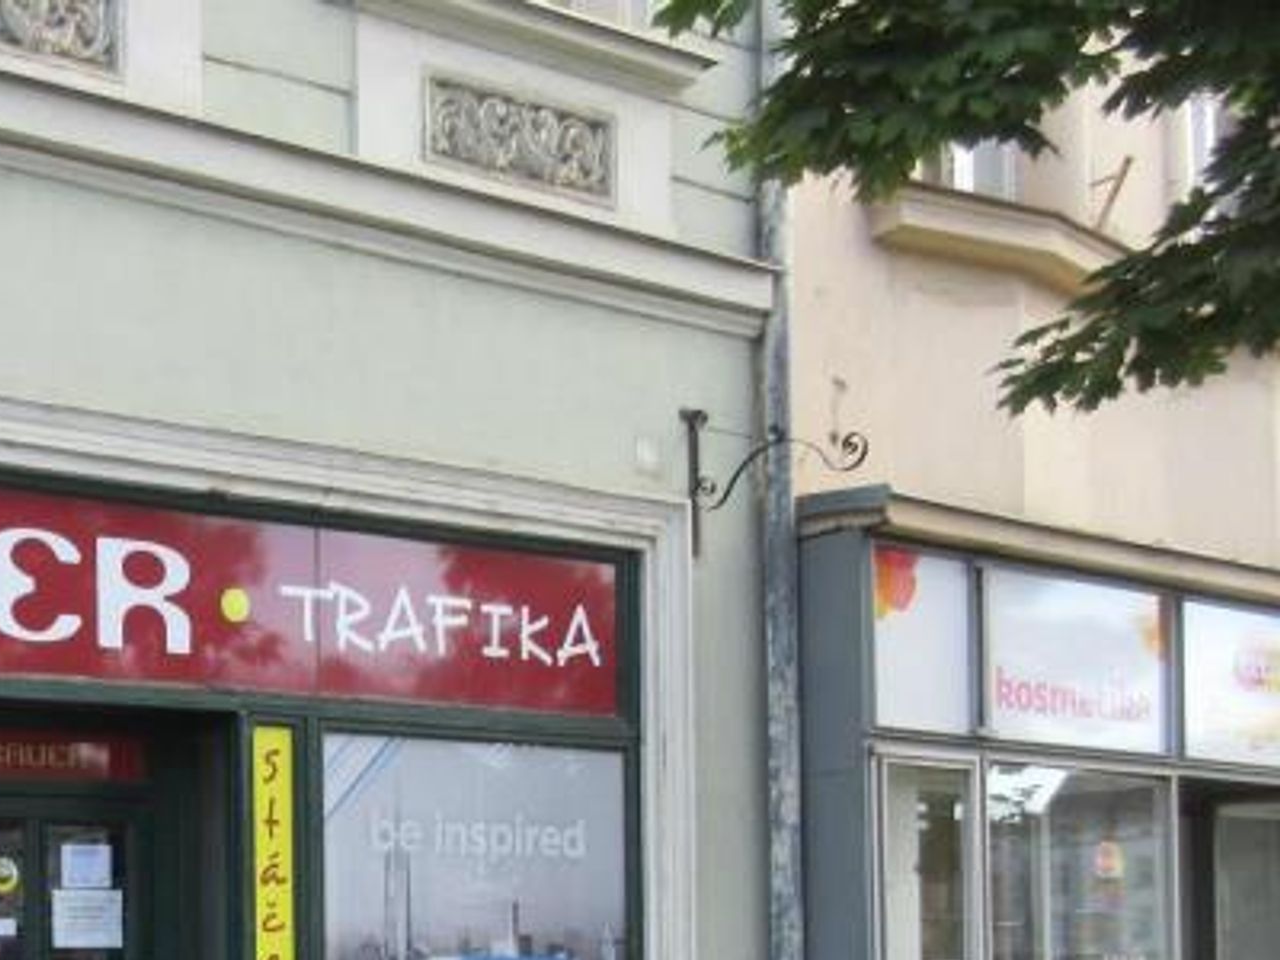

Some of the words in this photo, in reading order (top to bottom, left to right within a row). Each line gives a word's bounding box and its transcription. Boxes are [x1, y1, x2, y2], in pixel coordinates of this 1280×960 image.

[280, 580, 602, 668] TRAFIKA
[371, 816, 422, 850] be
[434, 812, 587, 864] inspired
